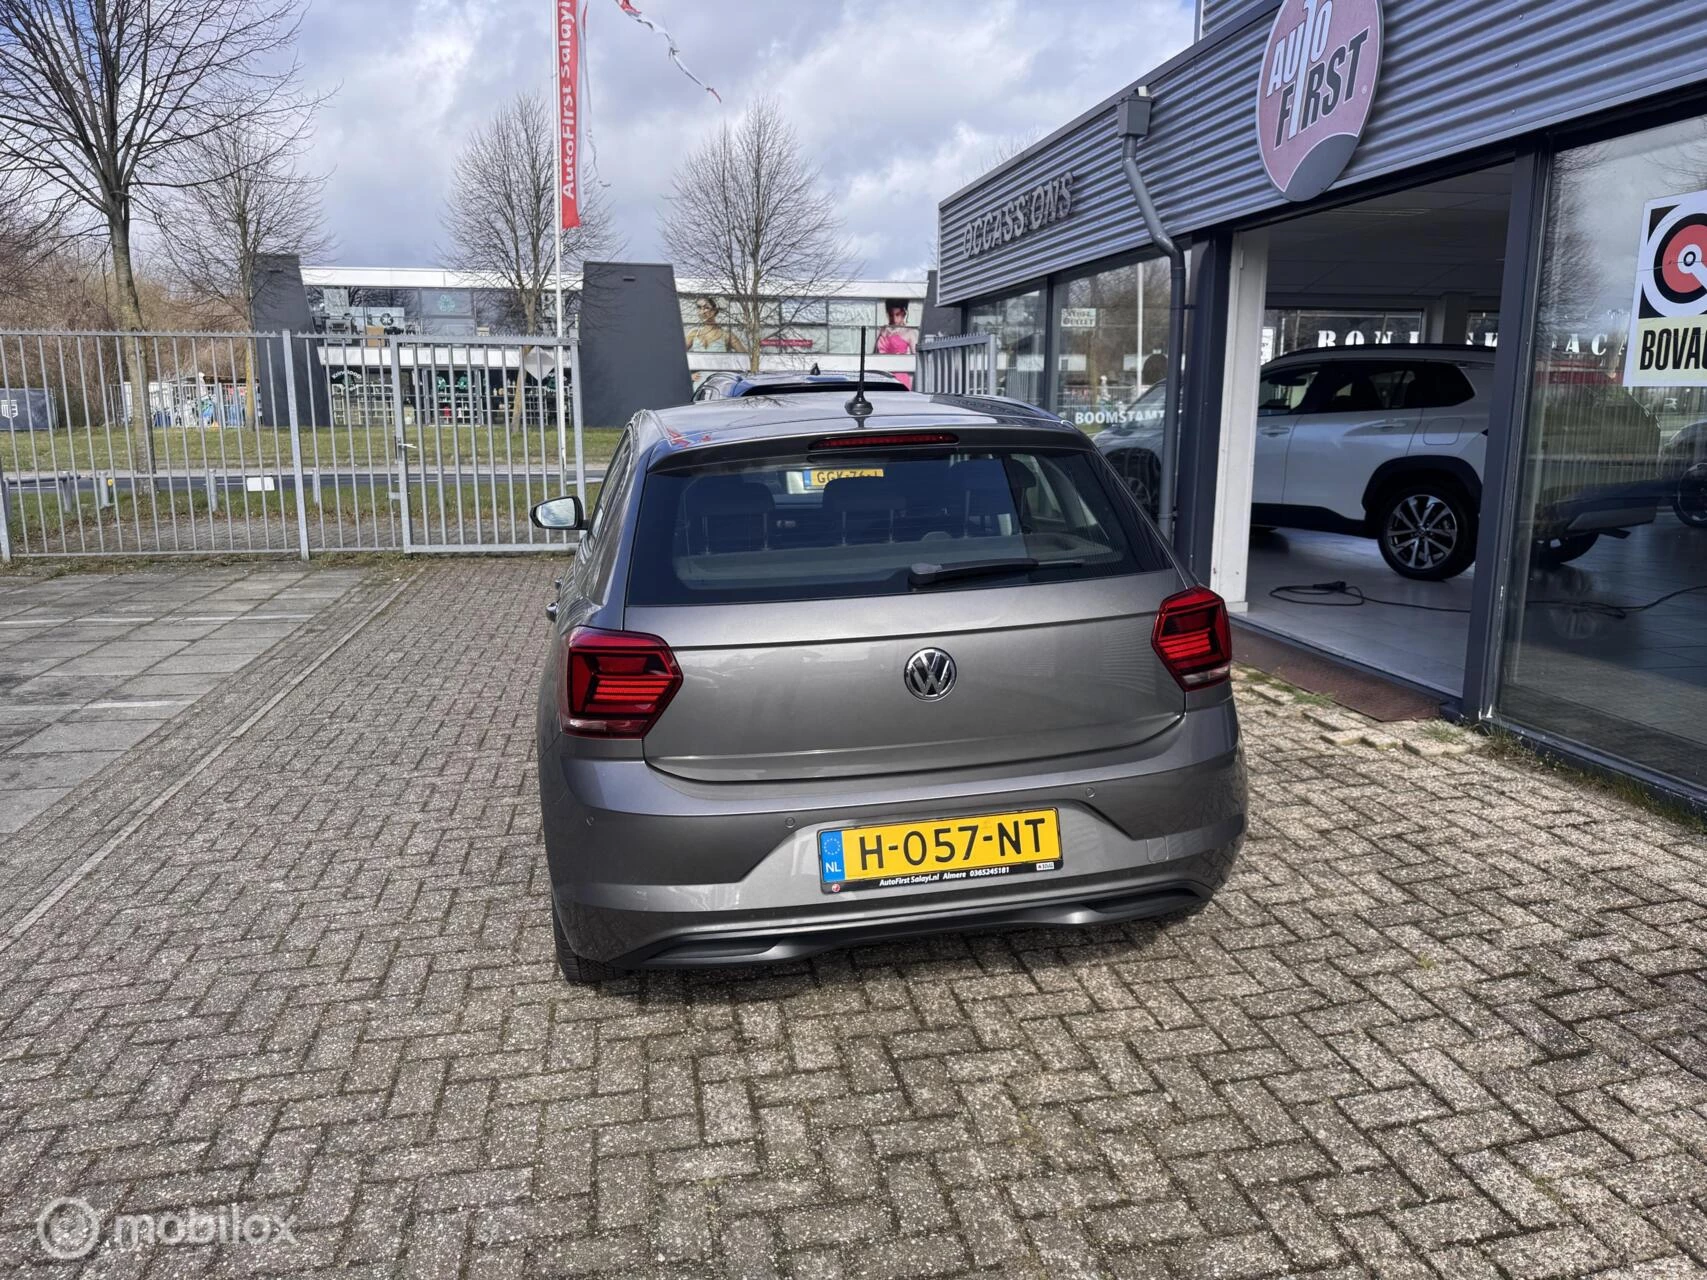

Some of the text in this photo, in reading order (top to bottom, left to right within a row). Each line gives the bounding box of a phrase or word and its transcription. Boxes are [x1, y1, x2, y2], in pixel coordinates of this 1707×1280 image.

[858, 817, 1046, 871] H-057-NT
[825, 862, 842, 873] NL
[942, 872, 967, 880] Almere
